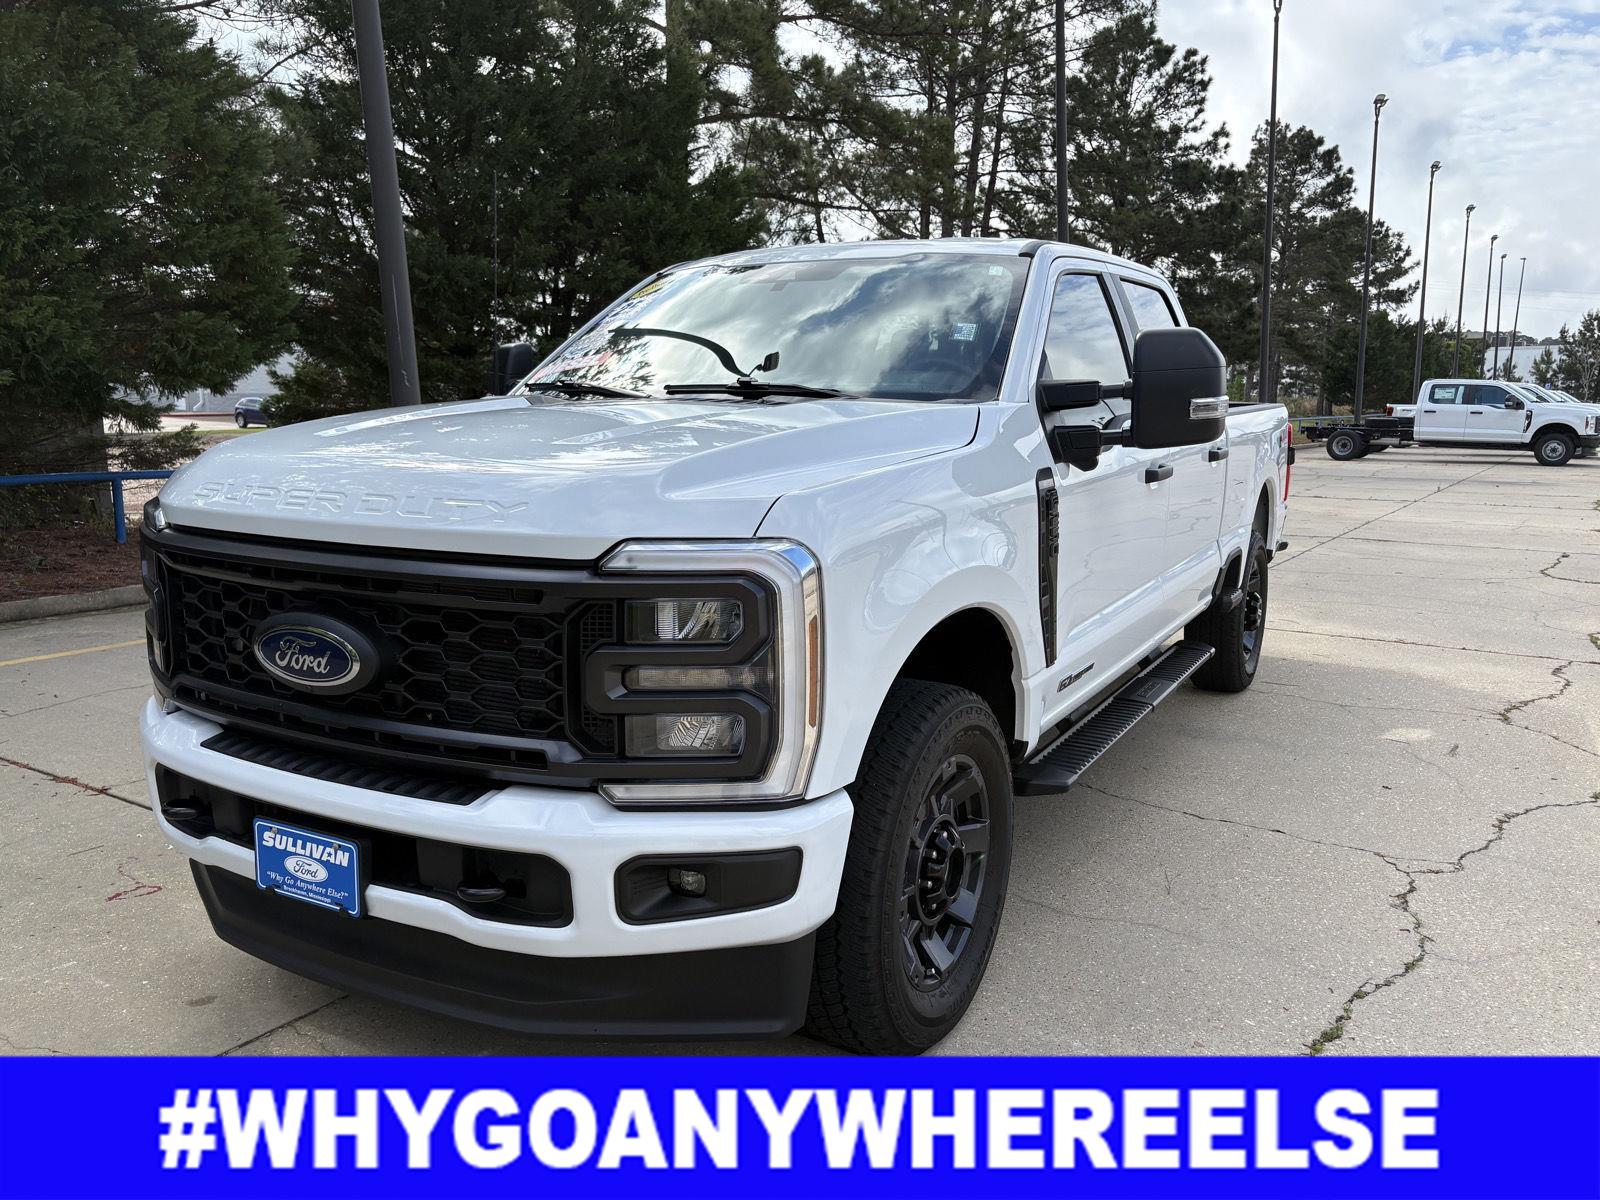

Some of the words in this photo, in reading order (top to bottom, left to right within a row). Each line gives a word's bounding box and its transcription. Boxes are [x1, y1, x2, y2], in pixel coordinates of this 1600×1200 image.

[193, 481, 348, 513] SUPER
[354, 493, 529, 523] DUTY
[275, 636, 331, 674] Ford
[262, 831, 350, 867] SULLIVAN
[285, 876, 295, 885] Go
[296, 880, 326, 895] Anywhere
[293, 860, 319, 879] Ford
